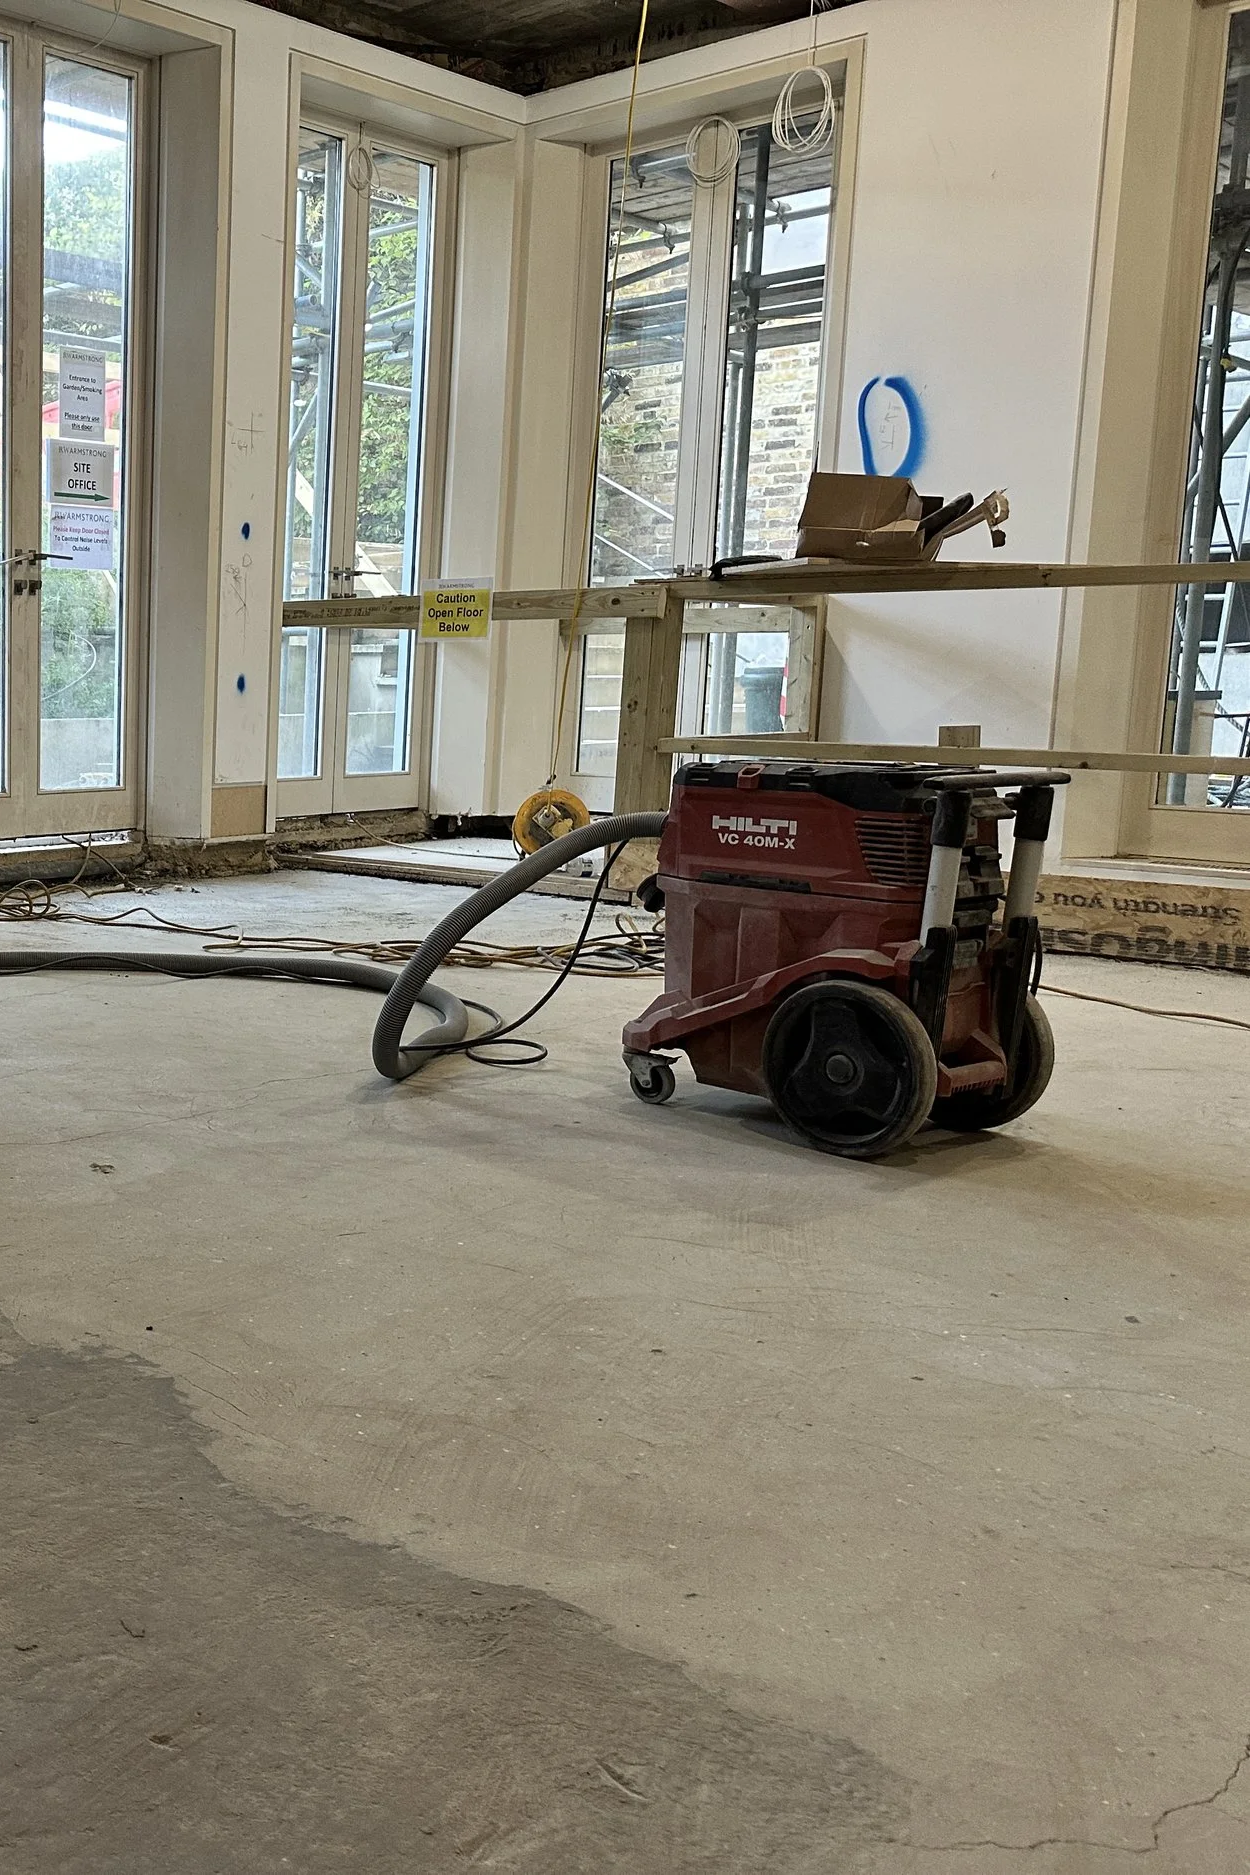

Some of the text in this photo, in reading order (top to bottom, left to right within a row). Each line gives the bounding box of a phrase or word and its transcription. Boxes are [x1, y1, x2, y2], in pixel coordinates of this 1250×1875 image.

[69, 374, 90, 383] Entrance
[63, 383, 102, 395] Garden/Smoking
[64, 411, 80, 420] Please
[80, 414, 91, 422] only
[73, 462, 91, 473] SITE
[67, 478, 97, 490] OFFICE
[436, 593, 476, 603] Caution
[428, 607, 484, 620] Open Floor
[438, 622, 470, 632] Below
[712, 815, 798, 836] HILTI
[718, 832, 796, 850] VC 40M-X
[1053, 891, 1105, 910] you
[1112, 895, 1242, 927] Strength
